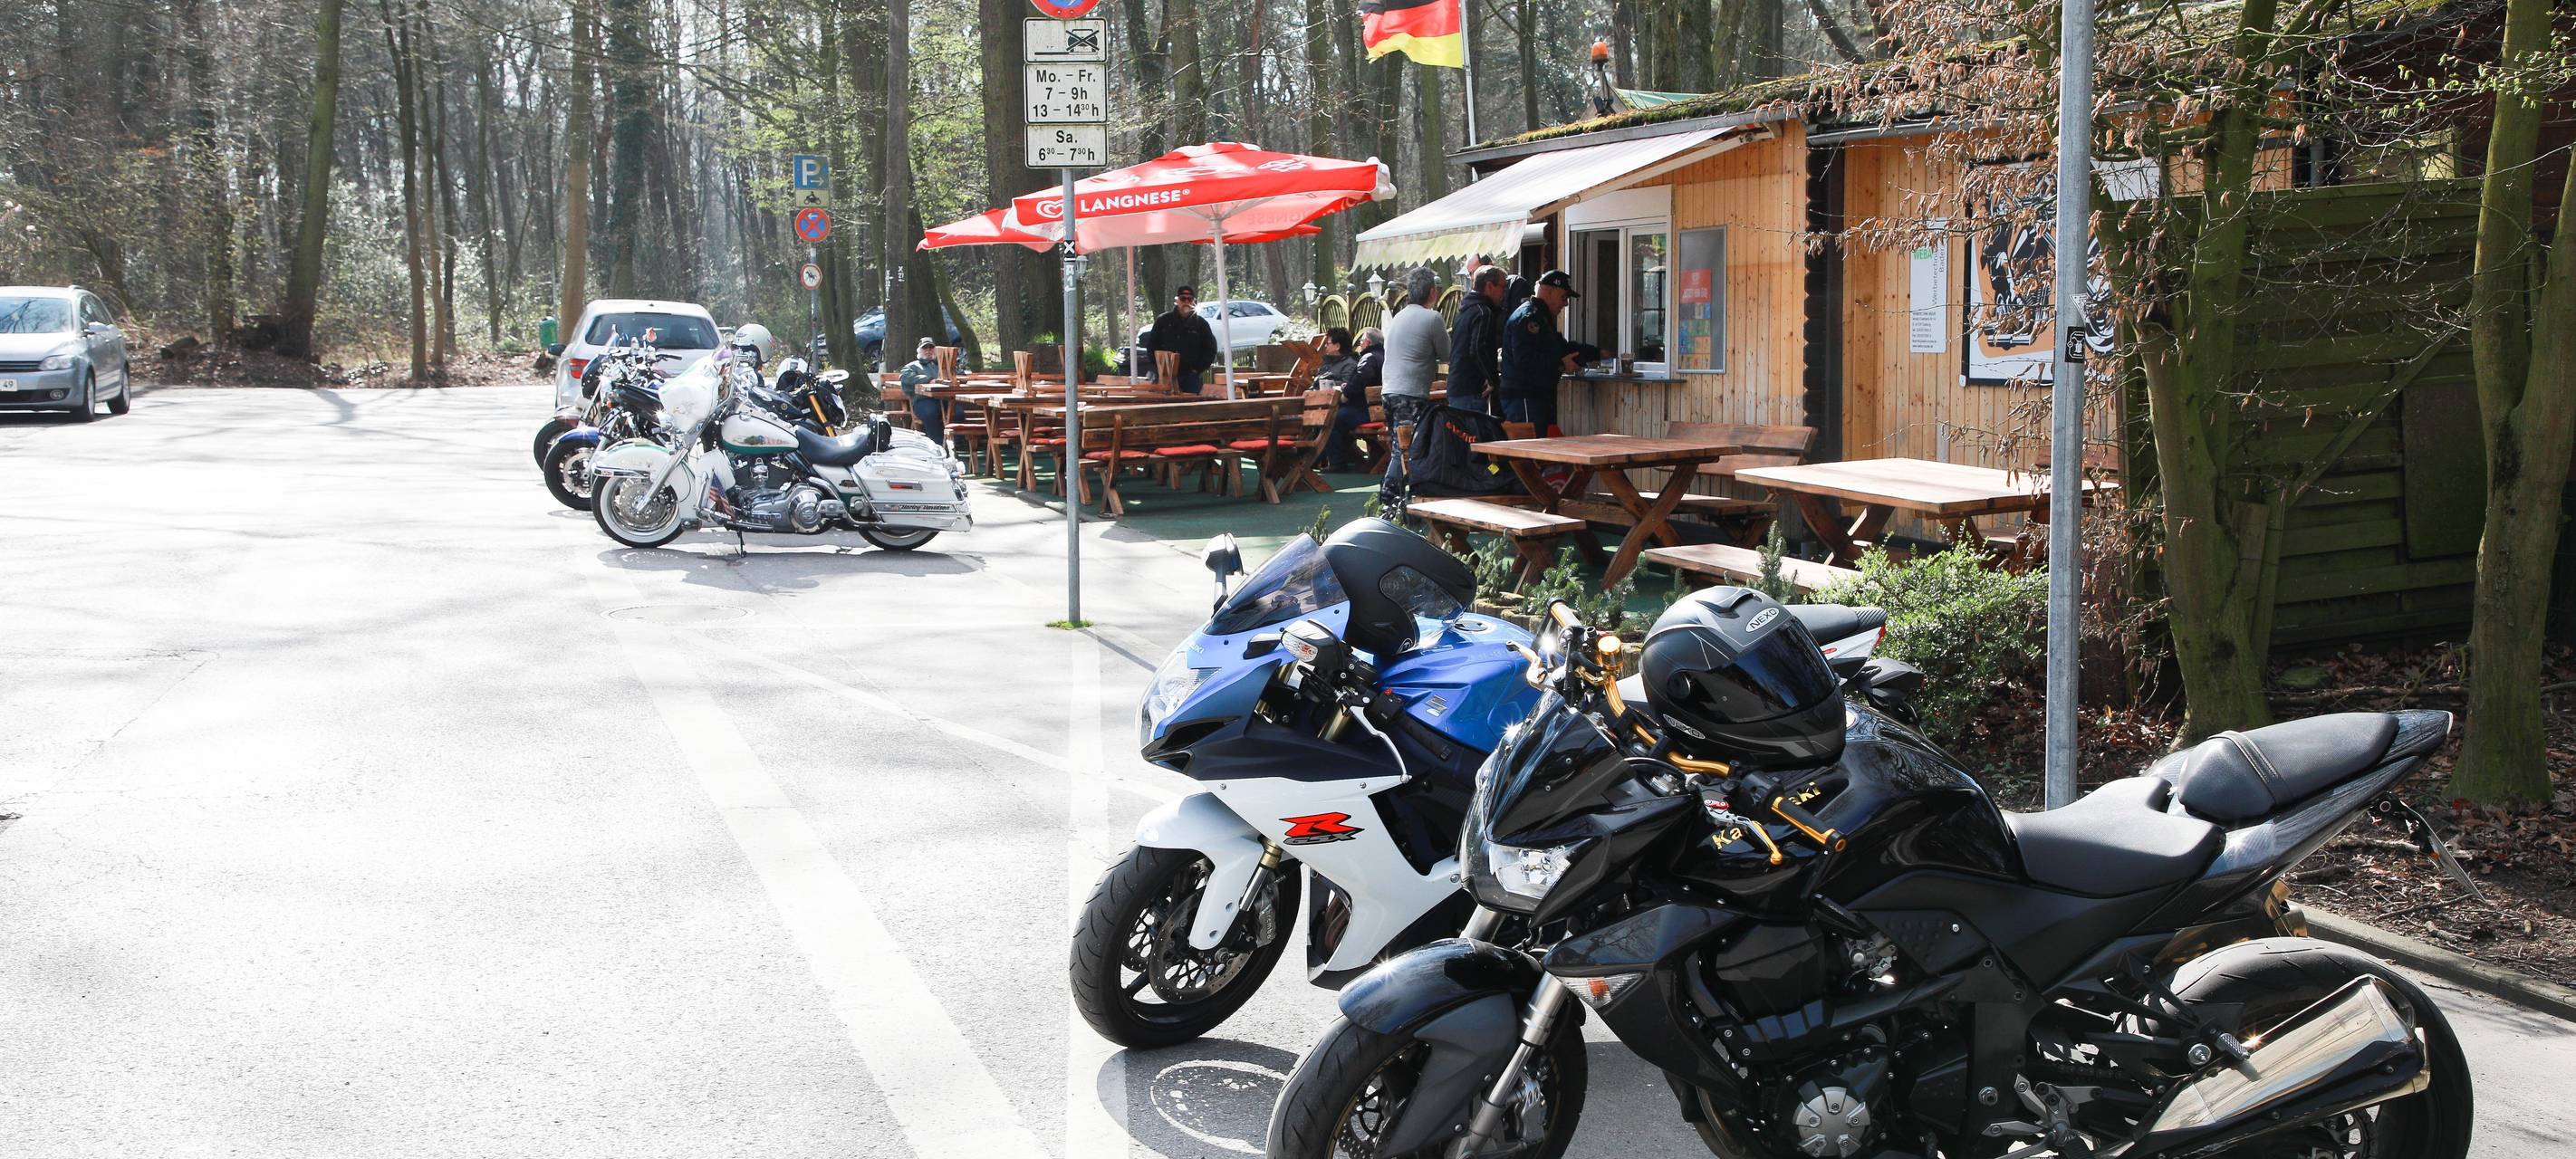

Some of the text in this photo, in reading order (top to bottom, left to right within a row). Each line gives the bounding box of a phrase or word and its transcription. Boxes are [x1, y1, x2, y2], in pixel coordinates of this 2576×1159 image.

[1036, 70, 1061, 82] Mo.
[1079, 70, 1096, 82] Fr.
[1045, 87, 1053, 100] 7
[1033, 104, 1048, 117] 13
[1056, 130, 1077, 143] Sa.
[802, 159, 821, 186] P
[3, 380, 14, 388] 49
[1749, 608, 1777, 629] NEXO
[1283, 833, 1357, 845] GSX
